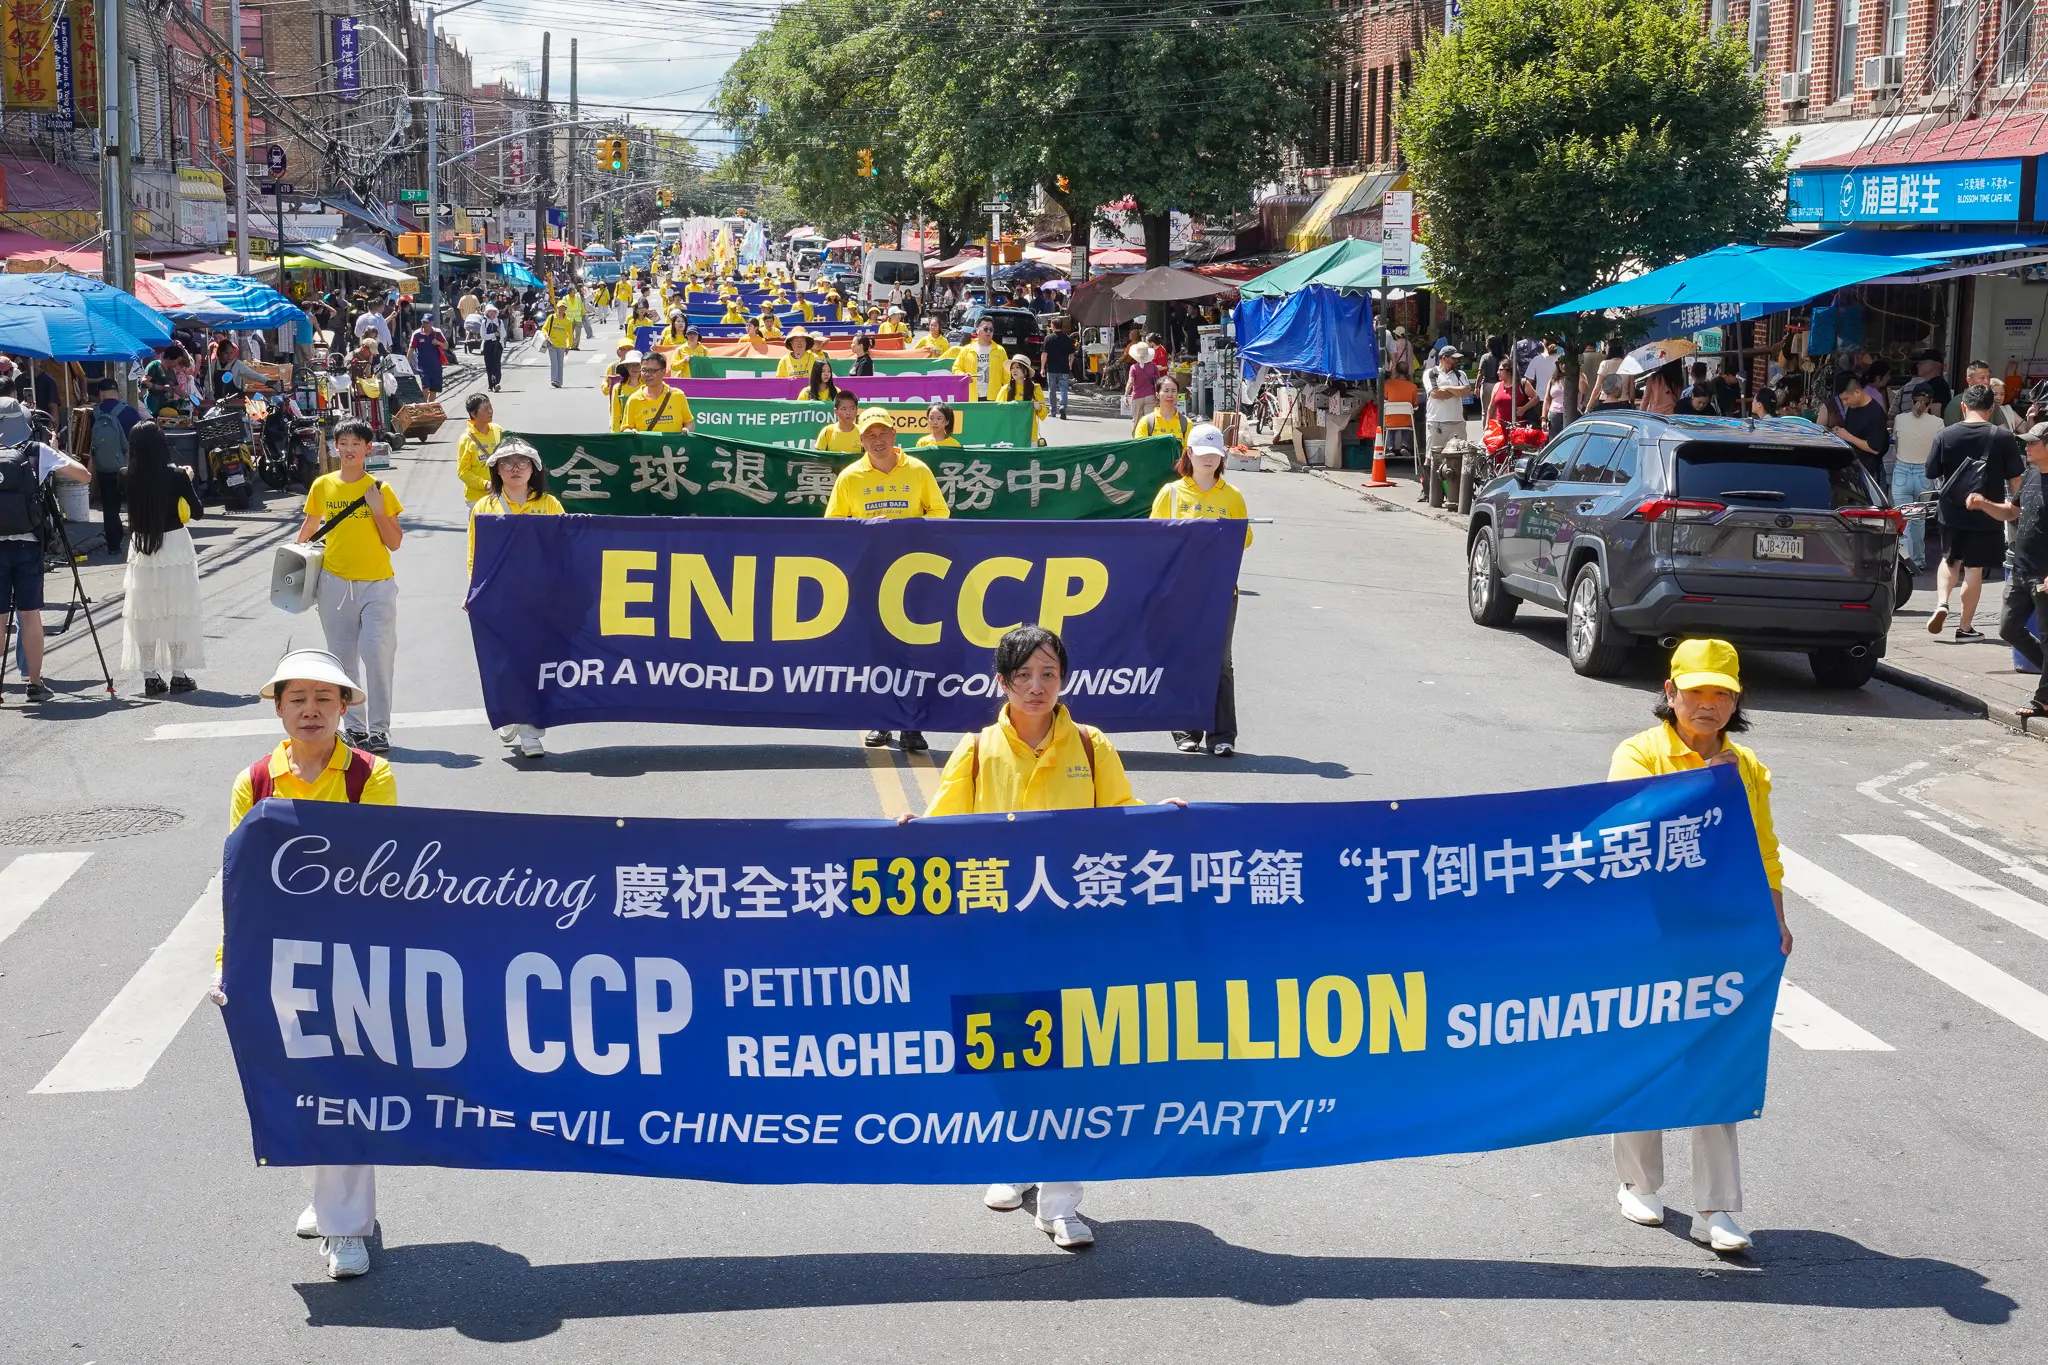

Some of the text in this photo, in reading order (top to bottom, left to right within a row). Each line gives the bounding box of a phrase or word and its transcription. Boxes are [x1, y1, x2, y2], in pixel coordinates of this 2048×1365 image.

[408, 191, 415, 199] 57
[1860, 173, 1941, 214] 捕鱼鲜生
[1957, 195, 1978, 203] BLOSSOM
[1979, 195, 1990, 203] TIME
[1990, 194, 2003, 202] CAFE
[696, 410, 838, 426] SIGN THE PETITION
[550, 445, 1136, 510] 全球退黨務中心
[325, 500, 349, 509] FALUN
[866, 502, 888, 510] FALUN
[600, 550, 1109, 649] END CCP
[538, 658, 605, 691] FOR
[611, 658, 638, 685] A
[645, 661, 774, 692] WORLD
[782, 665, 935, 697] WITHOUT
[270, 835, 597, 930] Celebrating
[723, 964, 911, 1007] PETITION
[270, 938, 693, 1076] END CCP
[727, 971, 1744, 1077] REACHED 5.3 MILLION SIGNATURES
[425, 1094, 516, 1129] THE
[530, 1110, 625, 1146] EVIL
[638, 1110, 843, 1145] CHINESE
[854, 1103, 1145, 1145] COMMUNIST
